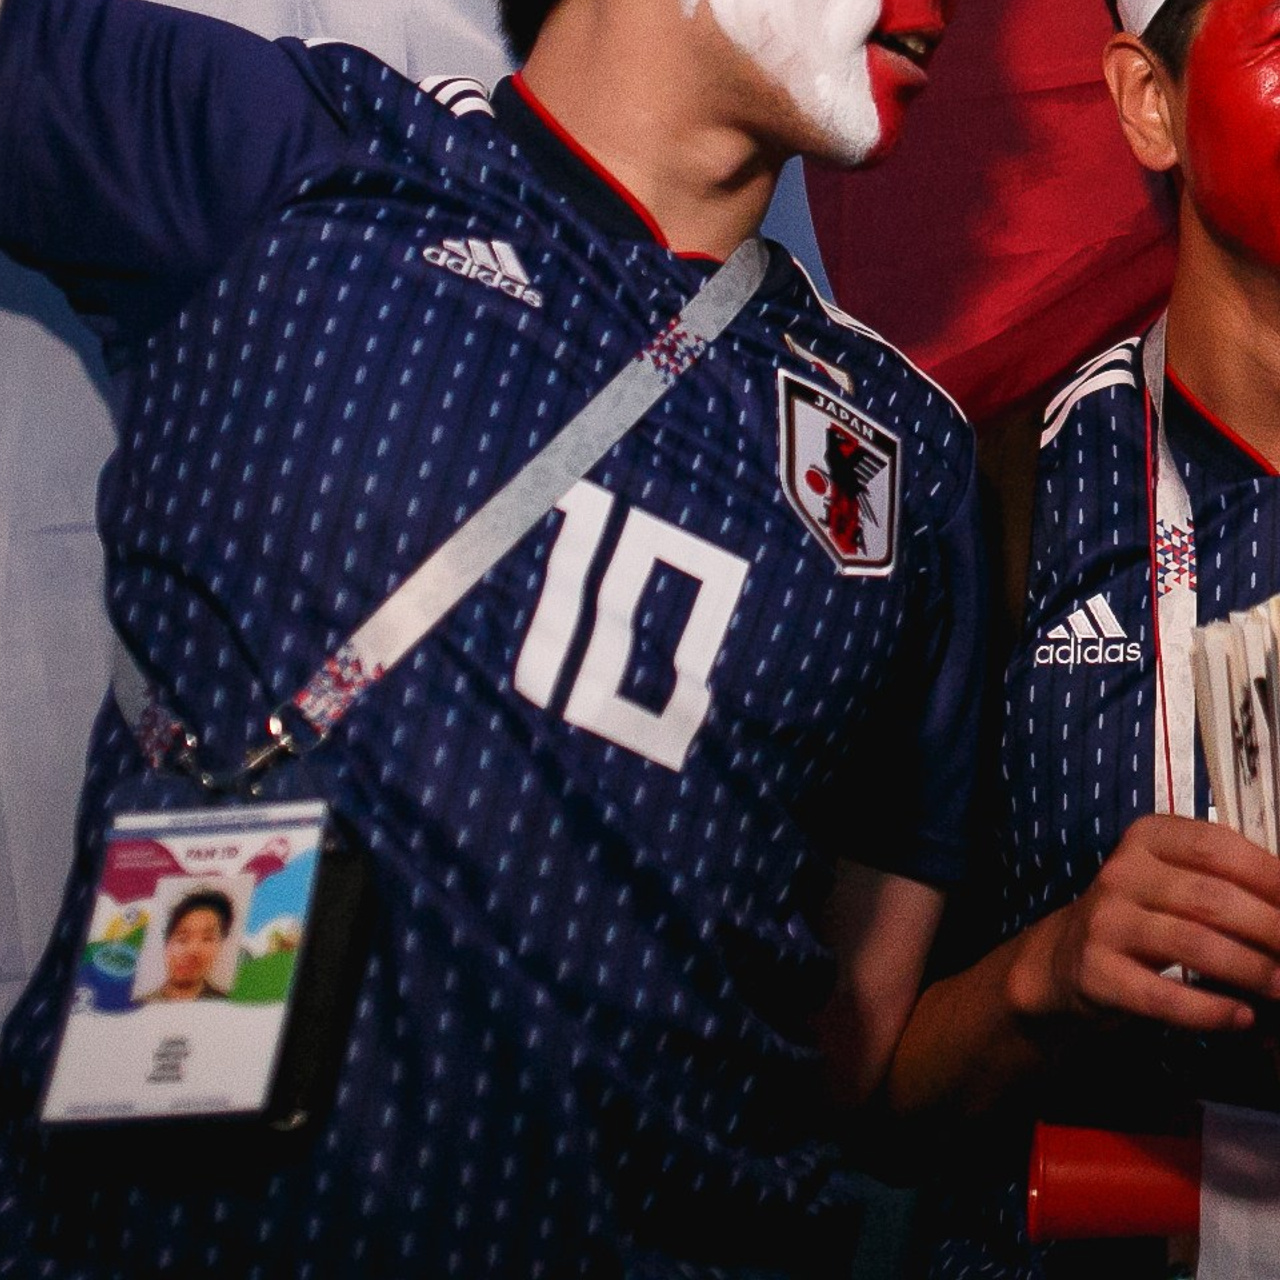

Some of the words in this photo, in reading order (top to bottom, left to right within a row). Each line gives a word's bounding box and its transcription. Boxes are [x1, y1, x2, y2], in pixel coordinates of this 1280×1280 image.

[423, 246, 543, 308] adidas
[814, 395, 874, 439] JAPAN
[514, 477, 750, 773] 10
[1036, 637, 1141, 664] adidas
